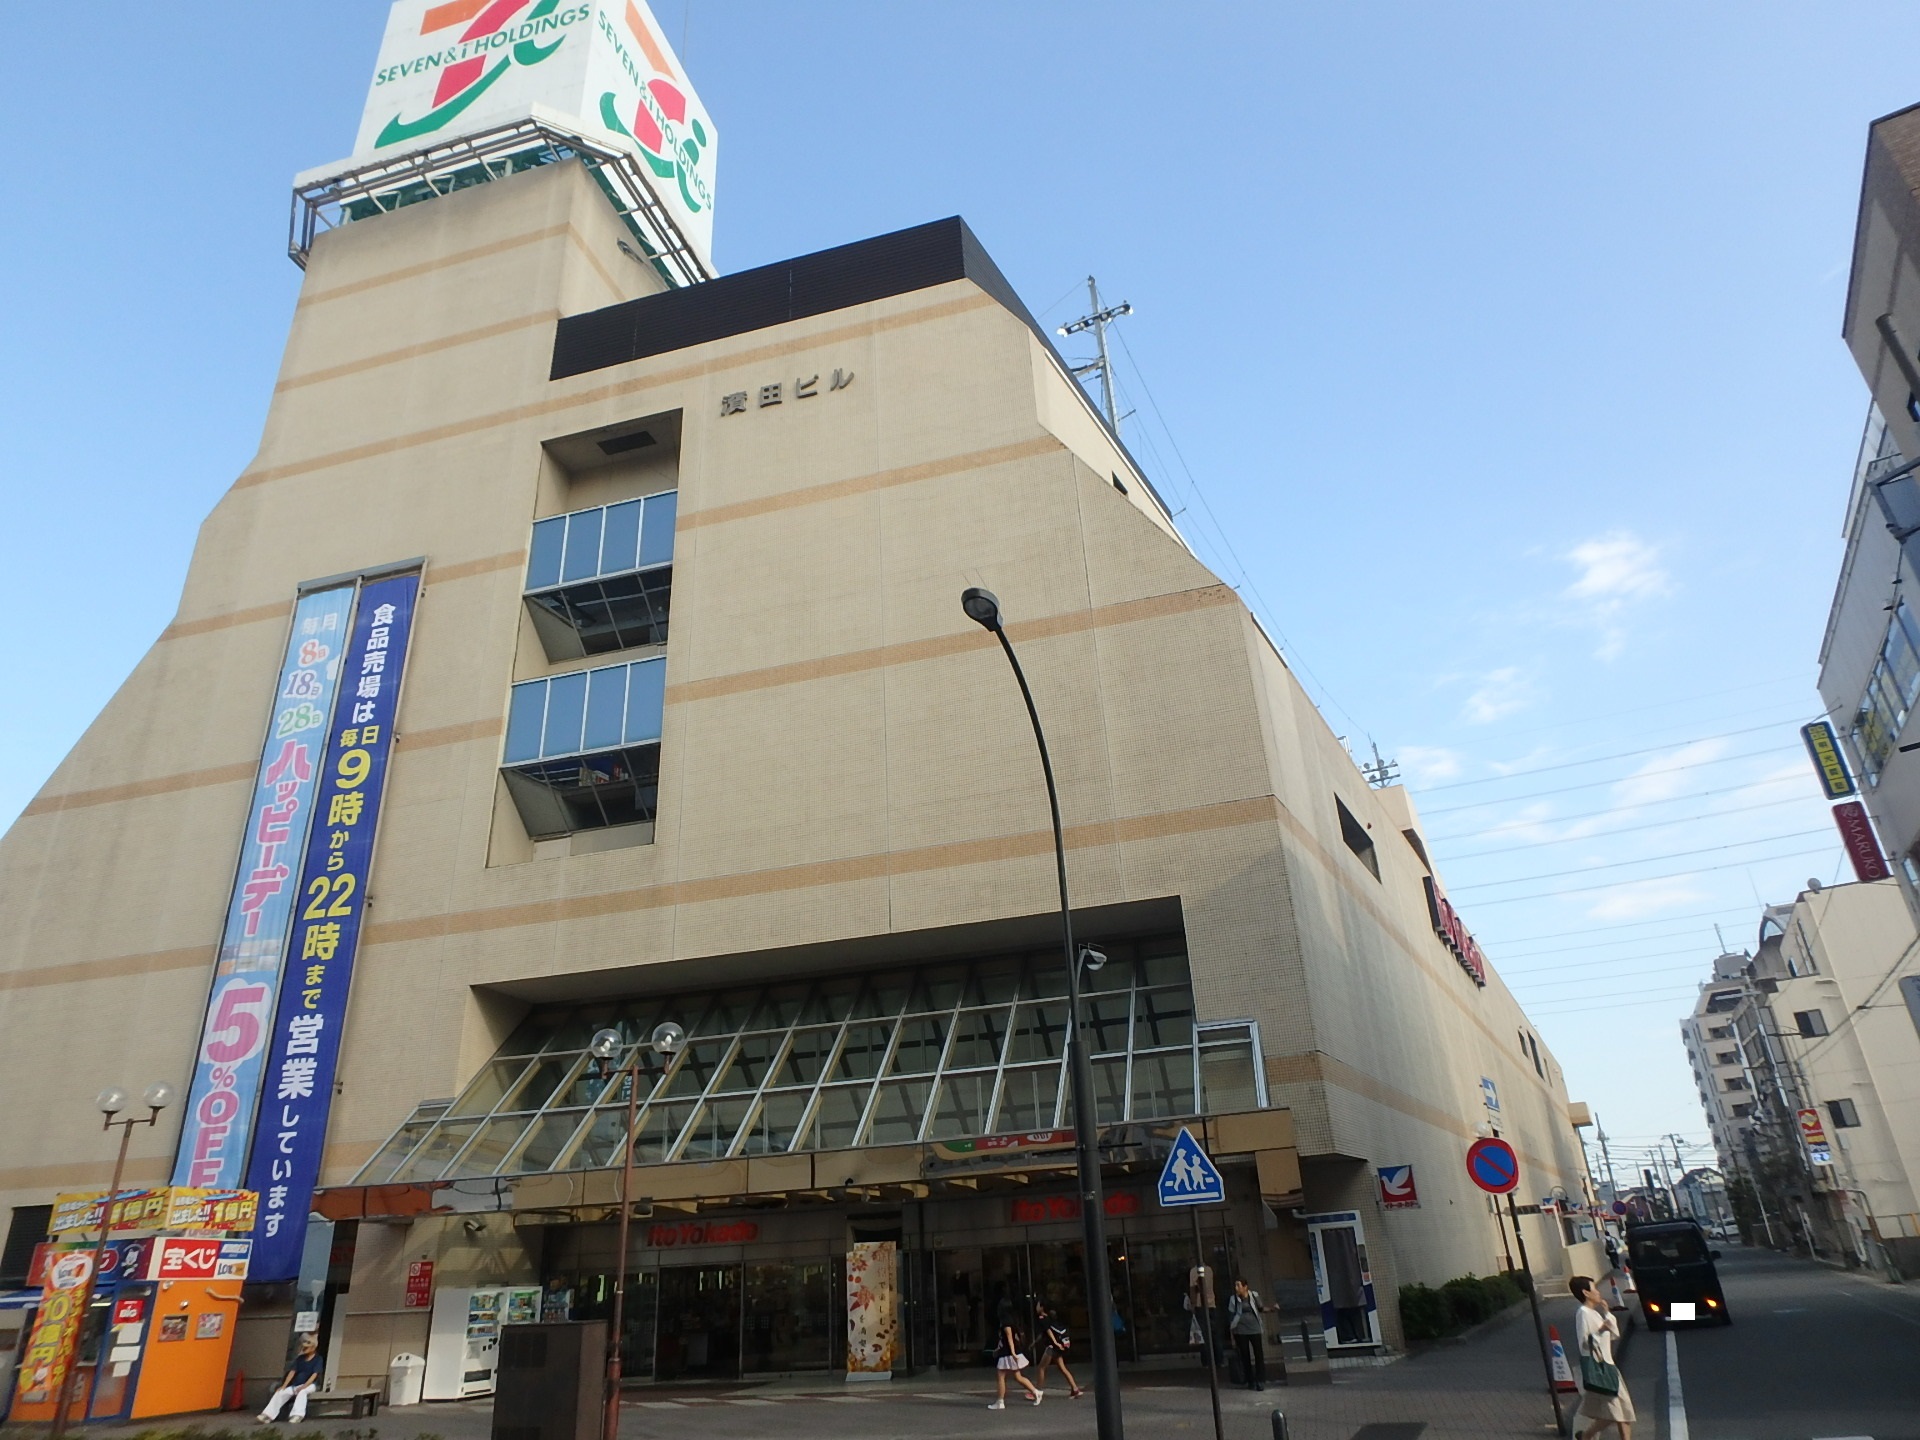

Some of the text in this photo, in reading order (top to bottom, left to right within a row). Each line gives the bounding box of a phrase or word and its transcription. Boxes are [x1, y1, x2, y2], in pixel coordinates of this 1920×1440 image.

[475, 4, 590, 54] HOLDINGS
[656, 110, 712, 210] HOLDINGS
[302, 613, 338, 635] 毎月
[299, 641, 328, 665] 8日
[285, 671, 321, 697] 18日
[279, 705, 322, 736] 28日
[240, 740, 311, 936] ハッピーデー
[1847, 819, 1881, 878] MARUKO
[162, 1247, 217, 1272] 宝くじ
